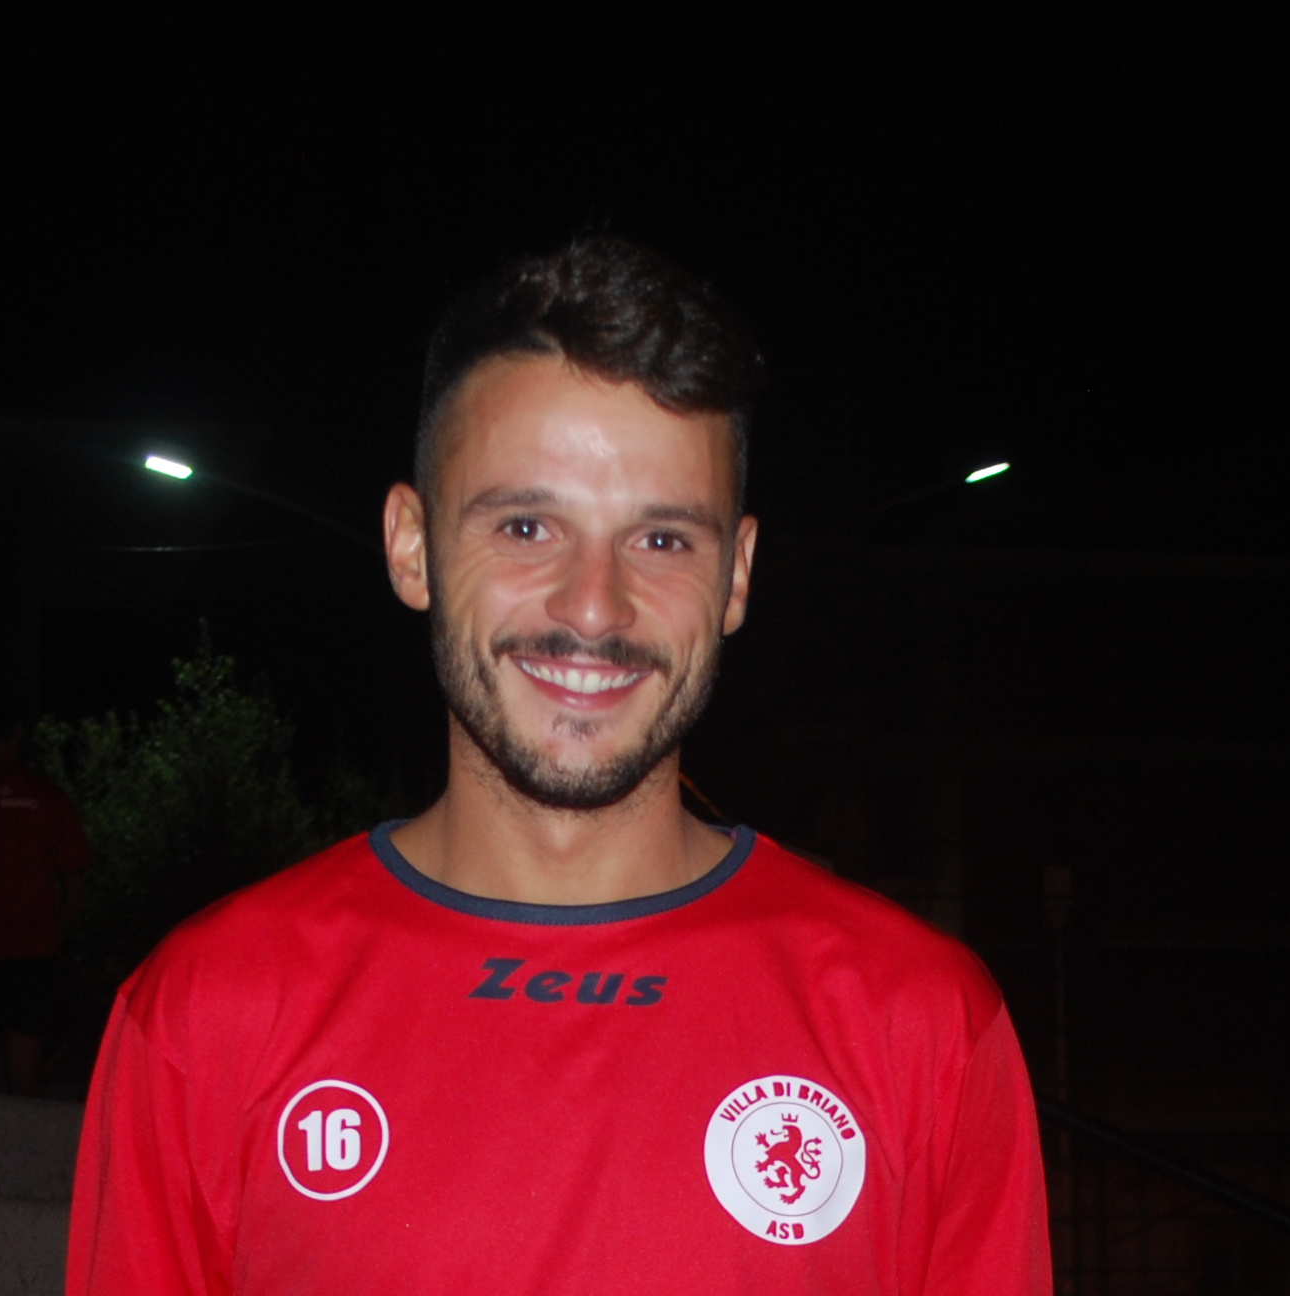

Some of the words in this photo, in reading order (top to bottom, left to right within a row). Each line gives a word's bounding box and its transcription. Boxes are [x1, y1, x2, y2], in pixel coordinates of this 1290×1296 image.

[467, 957, 668, 1006] Zeus
[719, 1085, 768, 1123] VILLA
[772, 1081, 791, 1097] DI
[797, 1084, 856, 1140] BRIANO
[298, 1108, 361, 1172] 16
[765, 1220, 805, 1240] ASD
